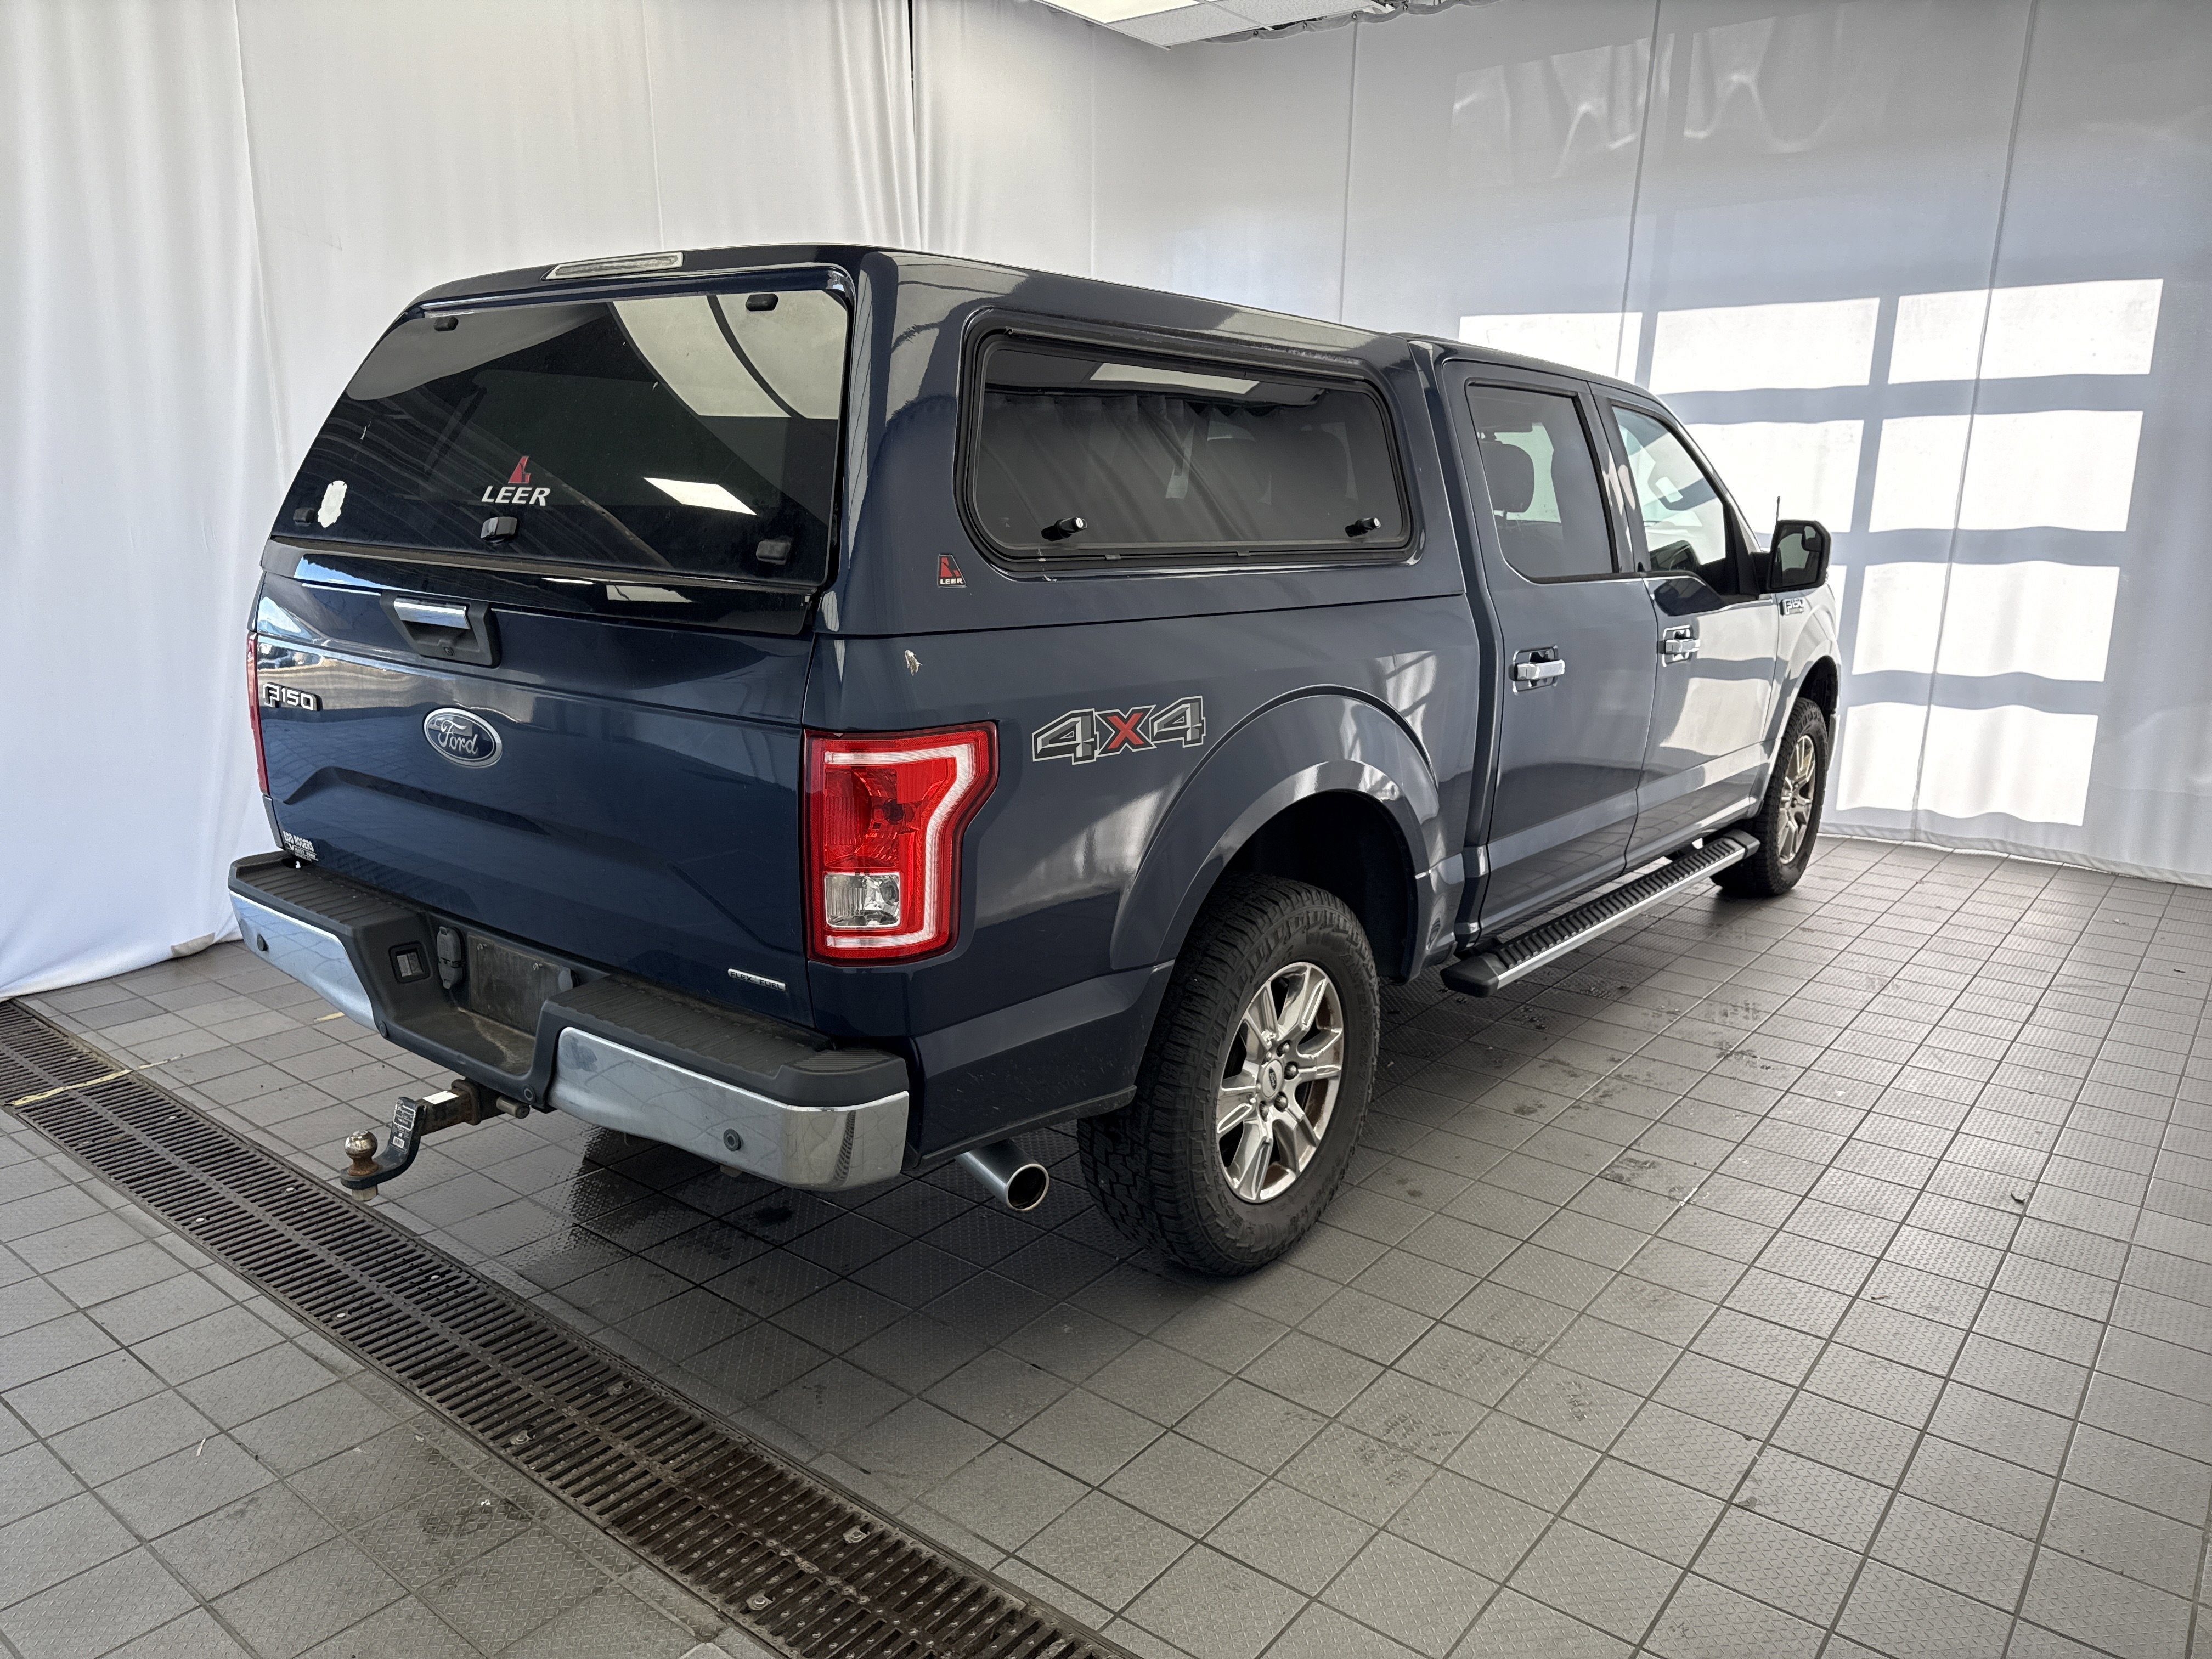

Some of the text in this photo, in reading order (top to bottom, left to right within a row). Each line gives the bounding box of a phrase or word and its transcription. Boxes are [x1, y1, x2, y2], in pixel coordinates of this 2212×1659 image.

[481, 486, 551, 506] LEER
[438, 719, 478, 754] Ford
[293, 834, 315, 853] ROGERS
[730, 971, 783, 991] FLEX FUEL
